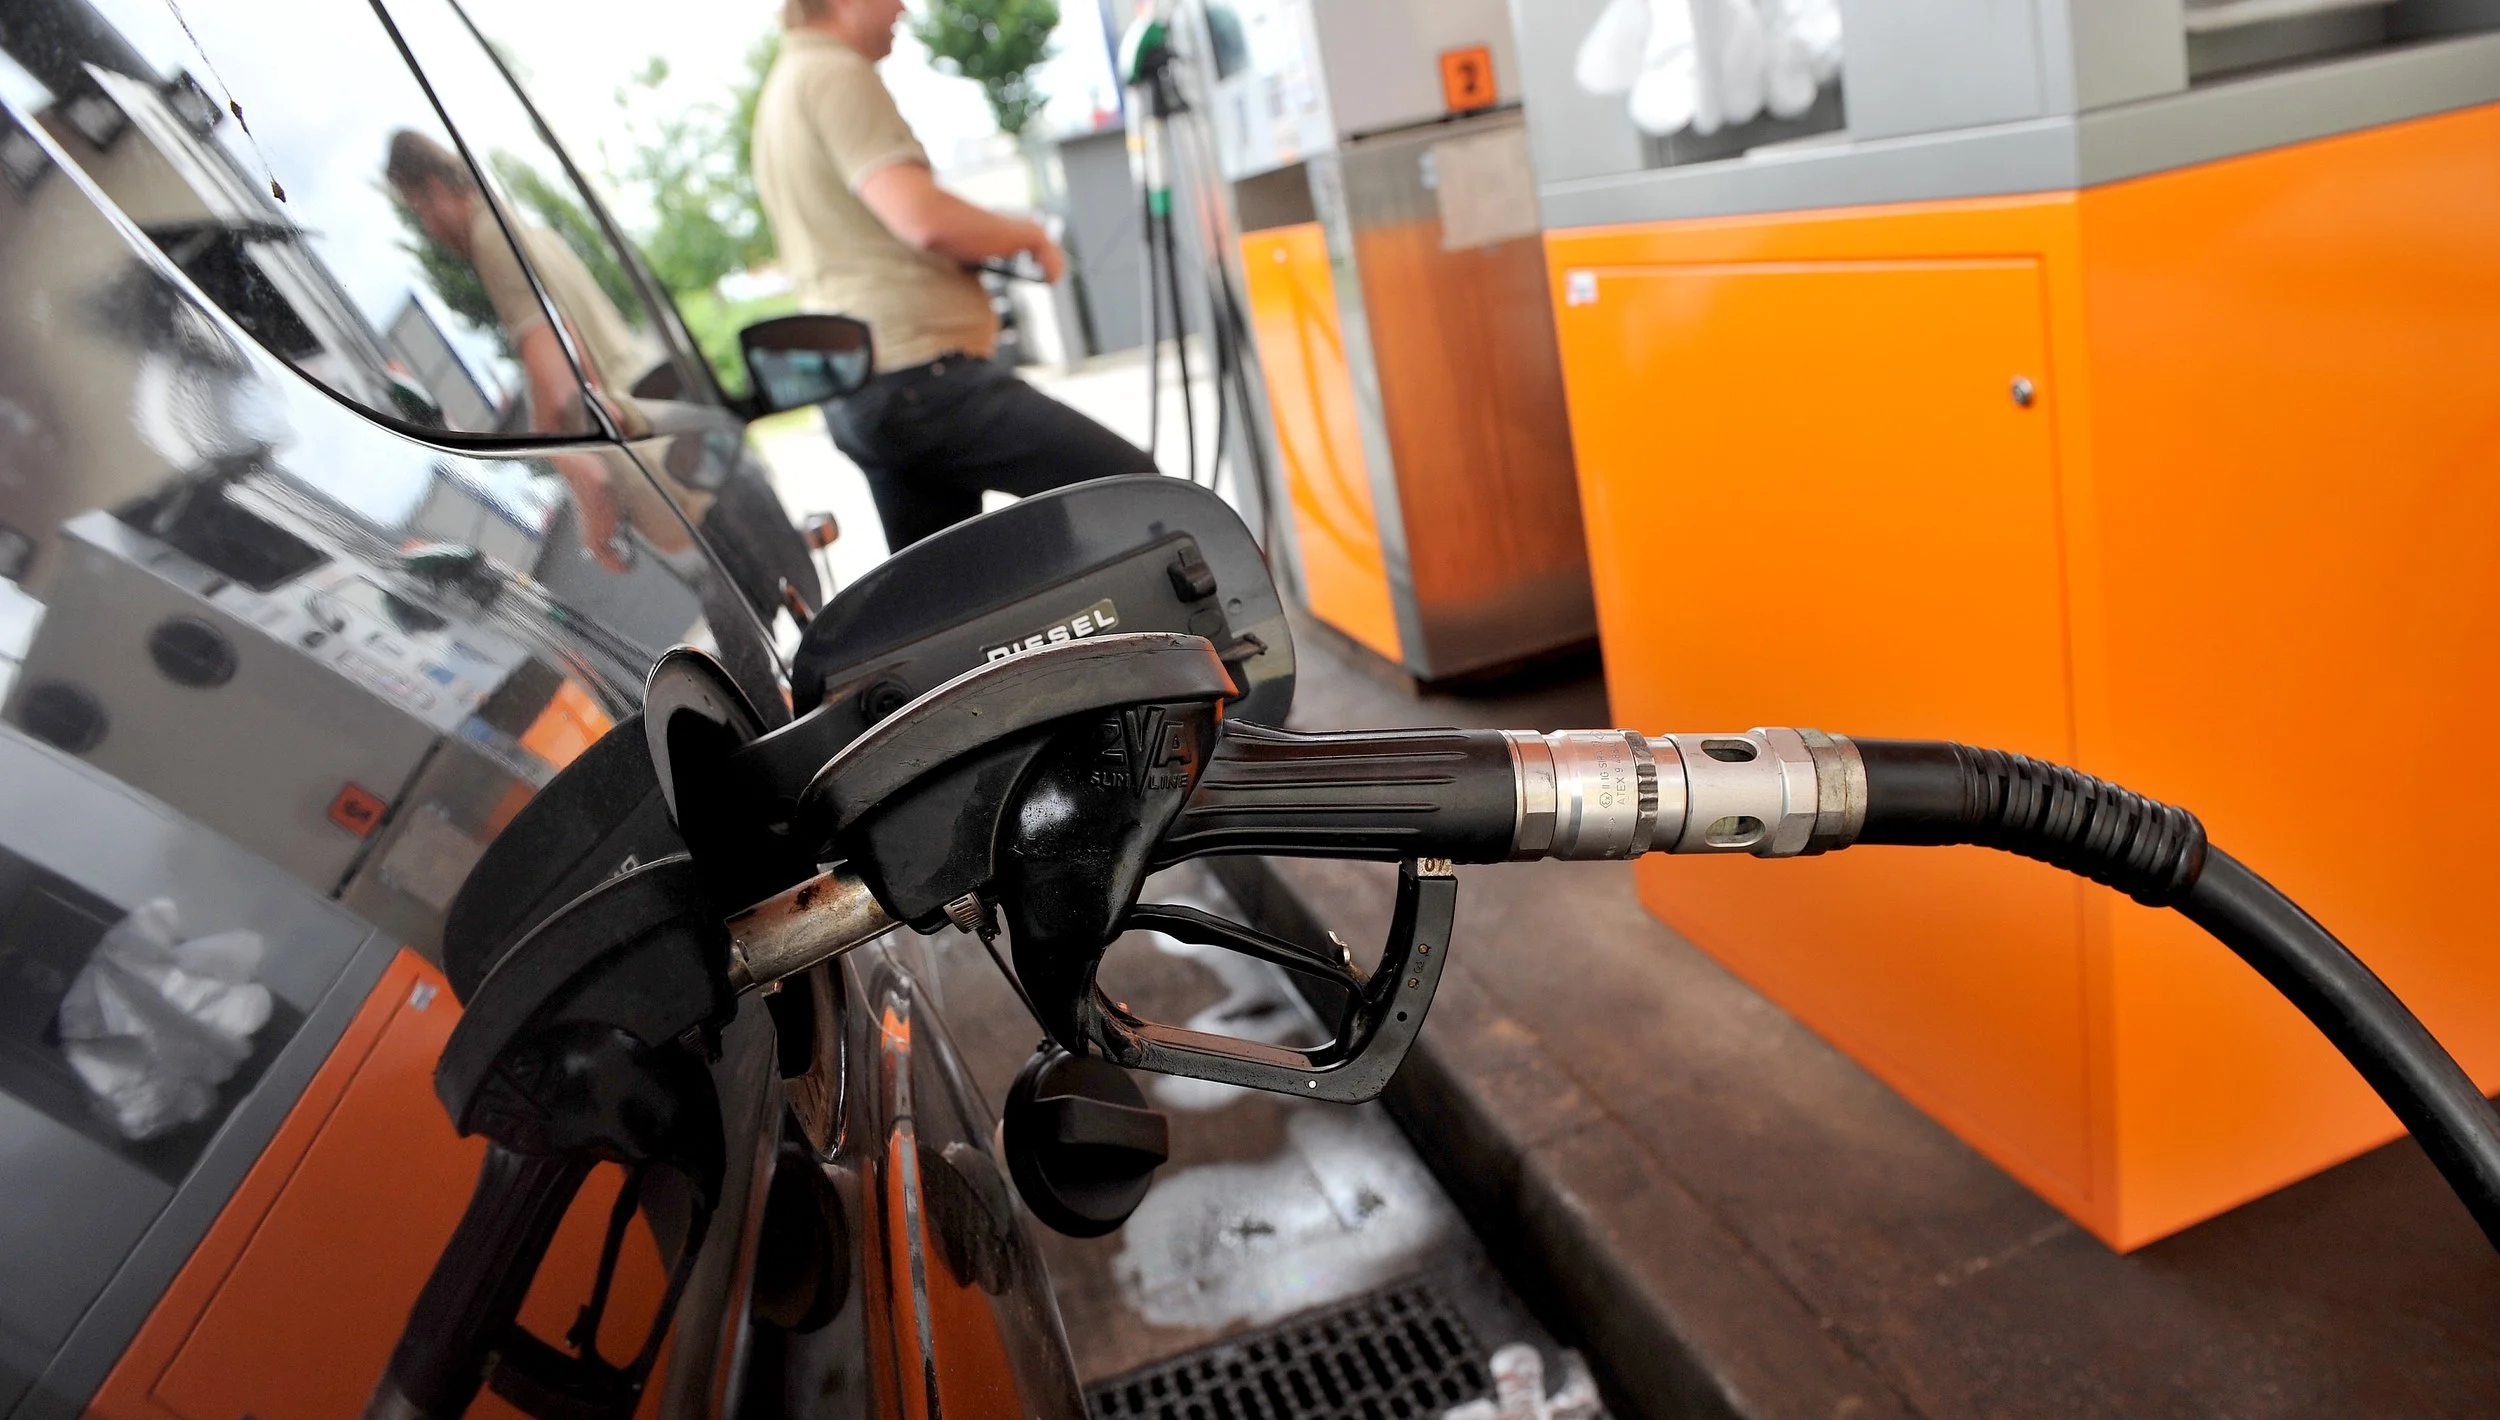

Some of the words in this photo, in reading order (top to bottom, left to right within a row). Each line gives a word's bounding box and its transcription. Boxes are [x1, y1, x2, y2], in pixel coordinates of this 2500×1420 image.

[1090, 769, 1131, 788] SLIM
[1148, 772, 1189, 790] LINE
[1616, 777, 1626, 805] ATEX
